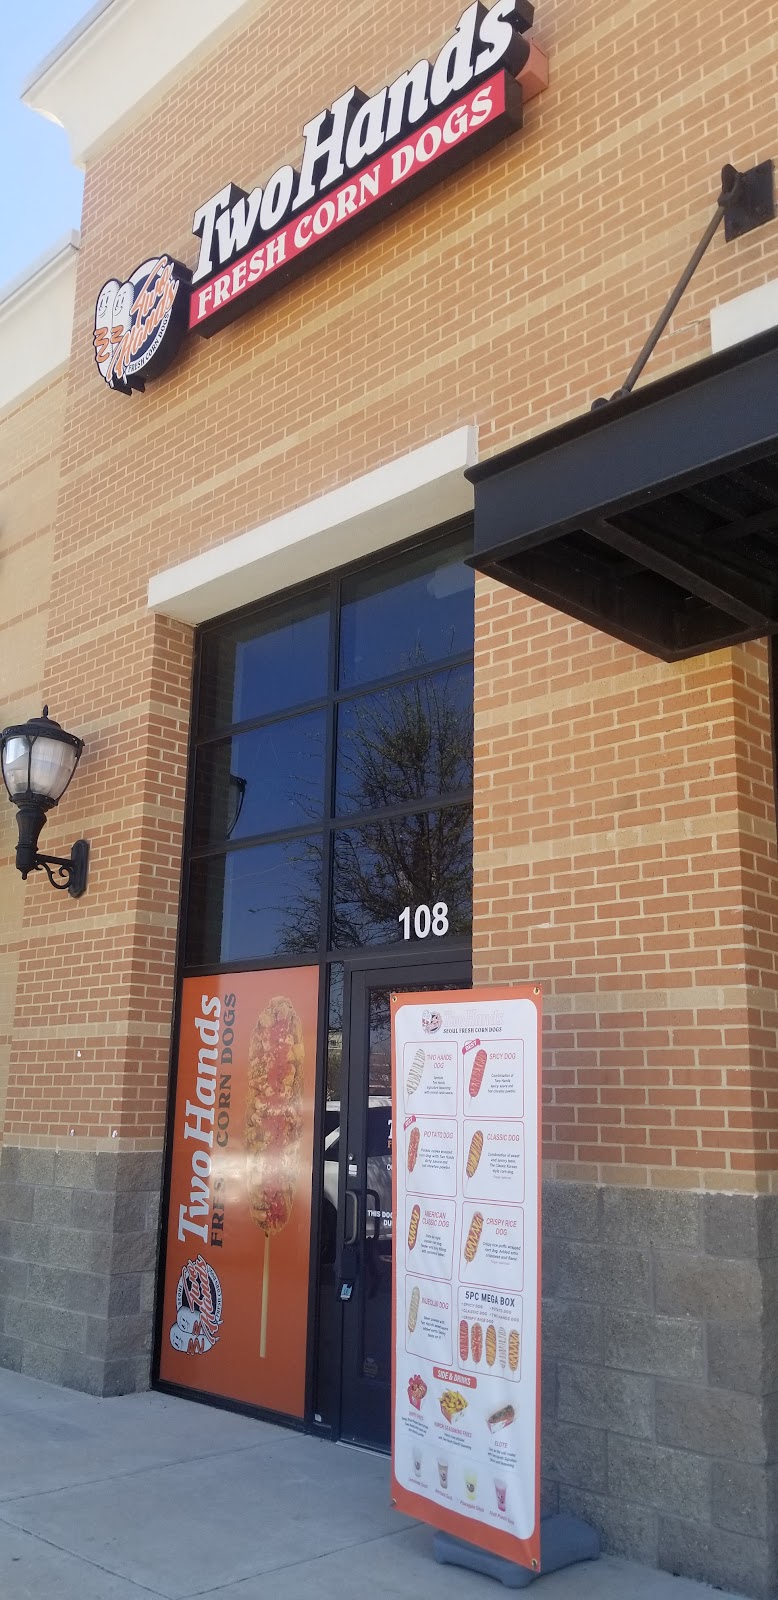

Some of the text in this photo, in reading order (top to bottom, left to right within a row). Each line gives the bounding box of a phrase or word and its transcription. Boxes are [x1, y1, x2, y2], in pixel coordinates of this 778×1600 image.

[192, 0, 518, 285] Two Hands
[197, 85, 494, 320] FRESH CORN DOGS
[127, 313, 170, 374] FRESH CORN DOGS
[398, 901, 449, 940] 108
[177, 994, 222, 1244] Two Hands
[209, 993, 237, 1249] FRES CORN DOGS
[368, 1210, 380, 1218] THIS
[425, 1210, 446, 1219] AMERICAN
[486, 1218, 504, 1226] CRISPY
[439, 1301, 449, 1309] DOG
[465, 1291, 515, 1307] 5PC MEGA BOX
[437, 1369, 448, 1380] SIDE
[454, 1373, 471, 1385] DRINKS
